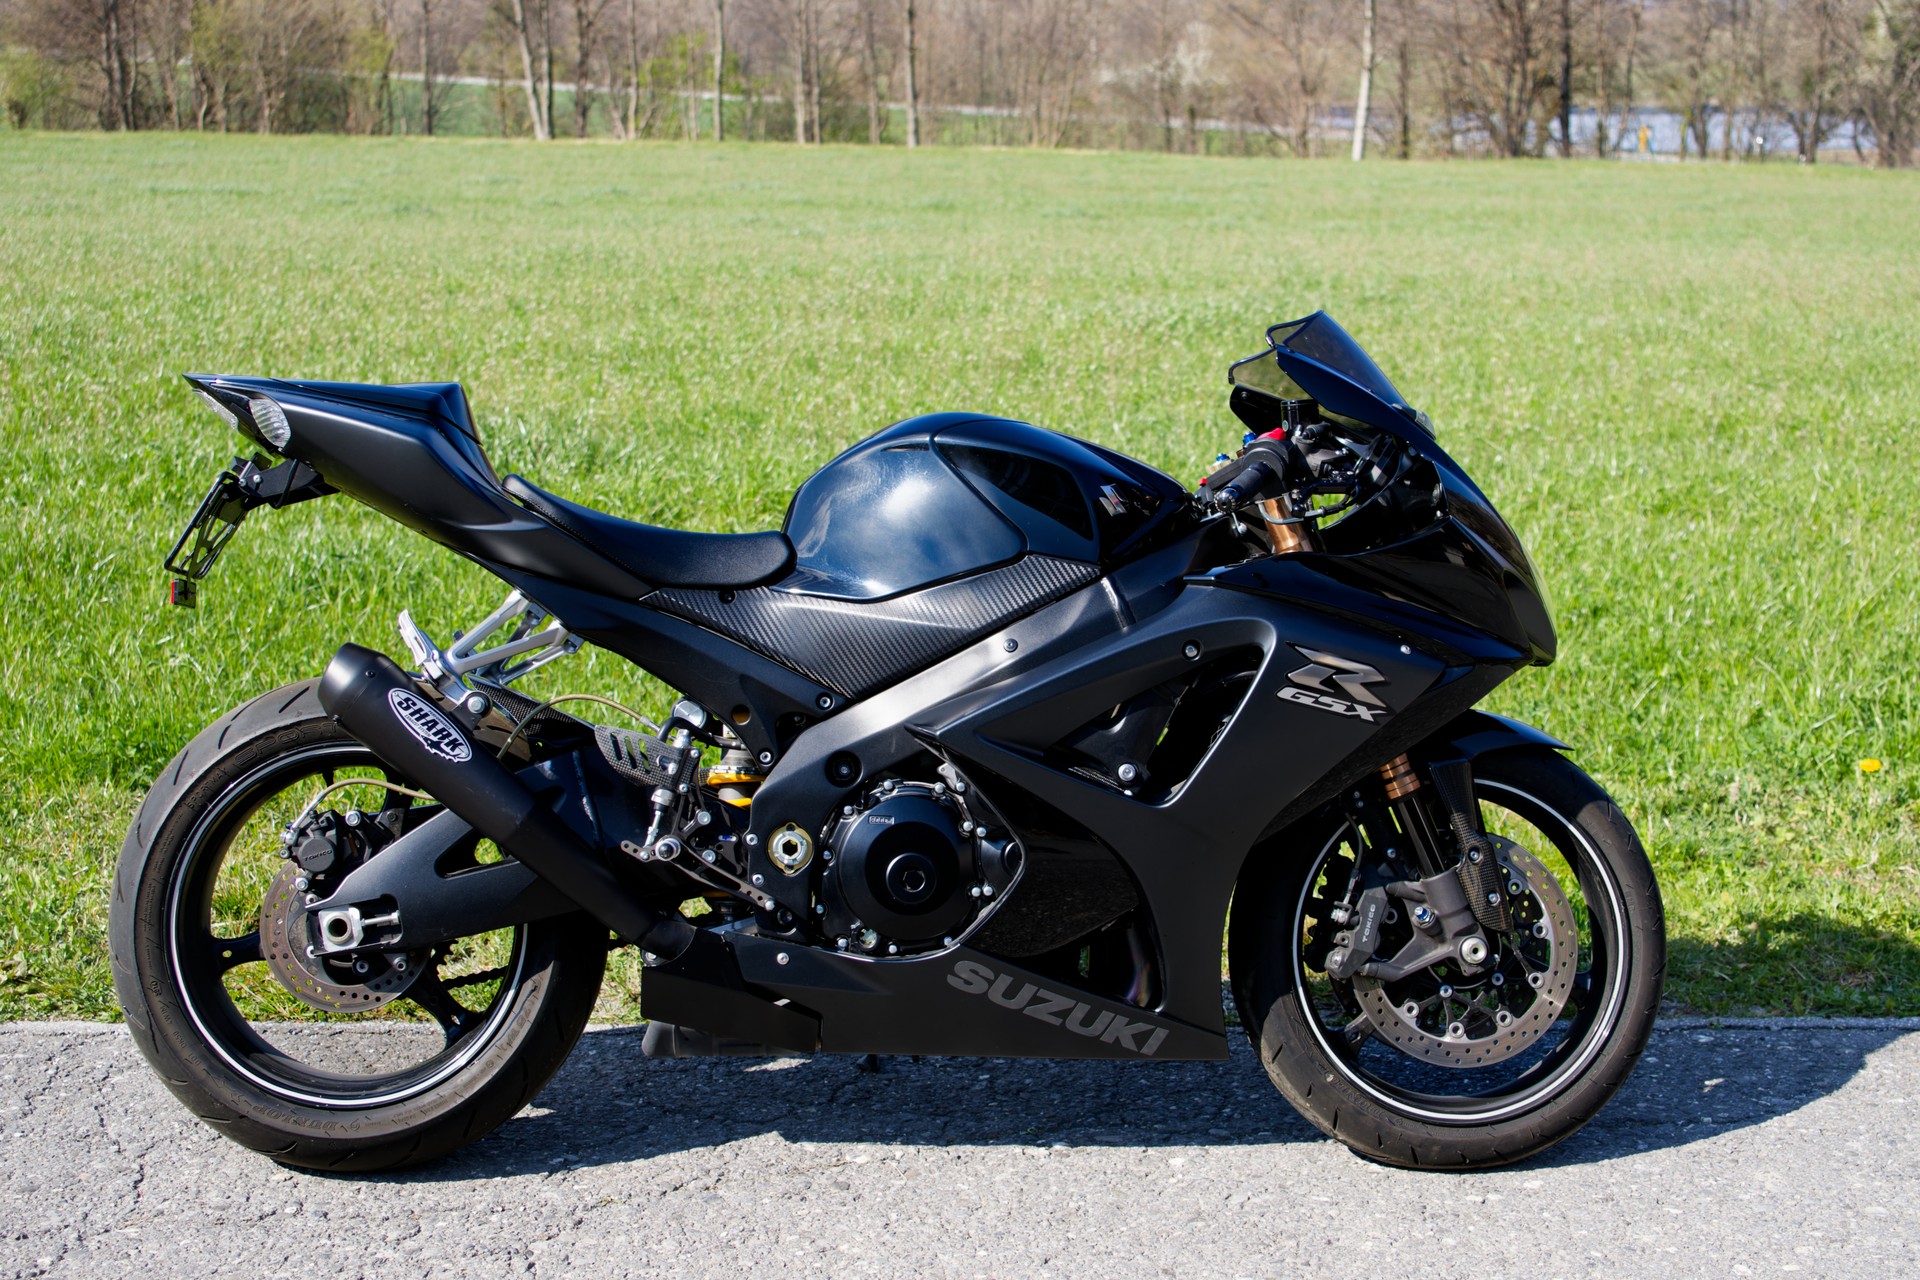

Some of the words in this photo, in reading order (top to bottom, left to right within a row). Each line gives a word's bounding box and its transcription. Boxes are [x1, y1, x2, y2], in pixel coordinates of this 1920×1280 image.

[396, 696, 465, 753] SHARK
[1276, 686, 1388, 722] GSX
[1361, 903, 1377, 943] TOKICO
[946, 960, 1170, 1056] SUZUKI
